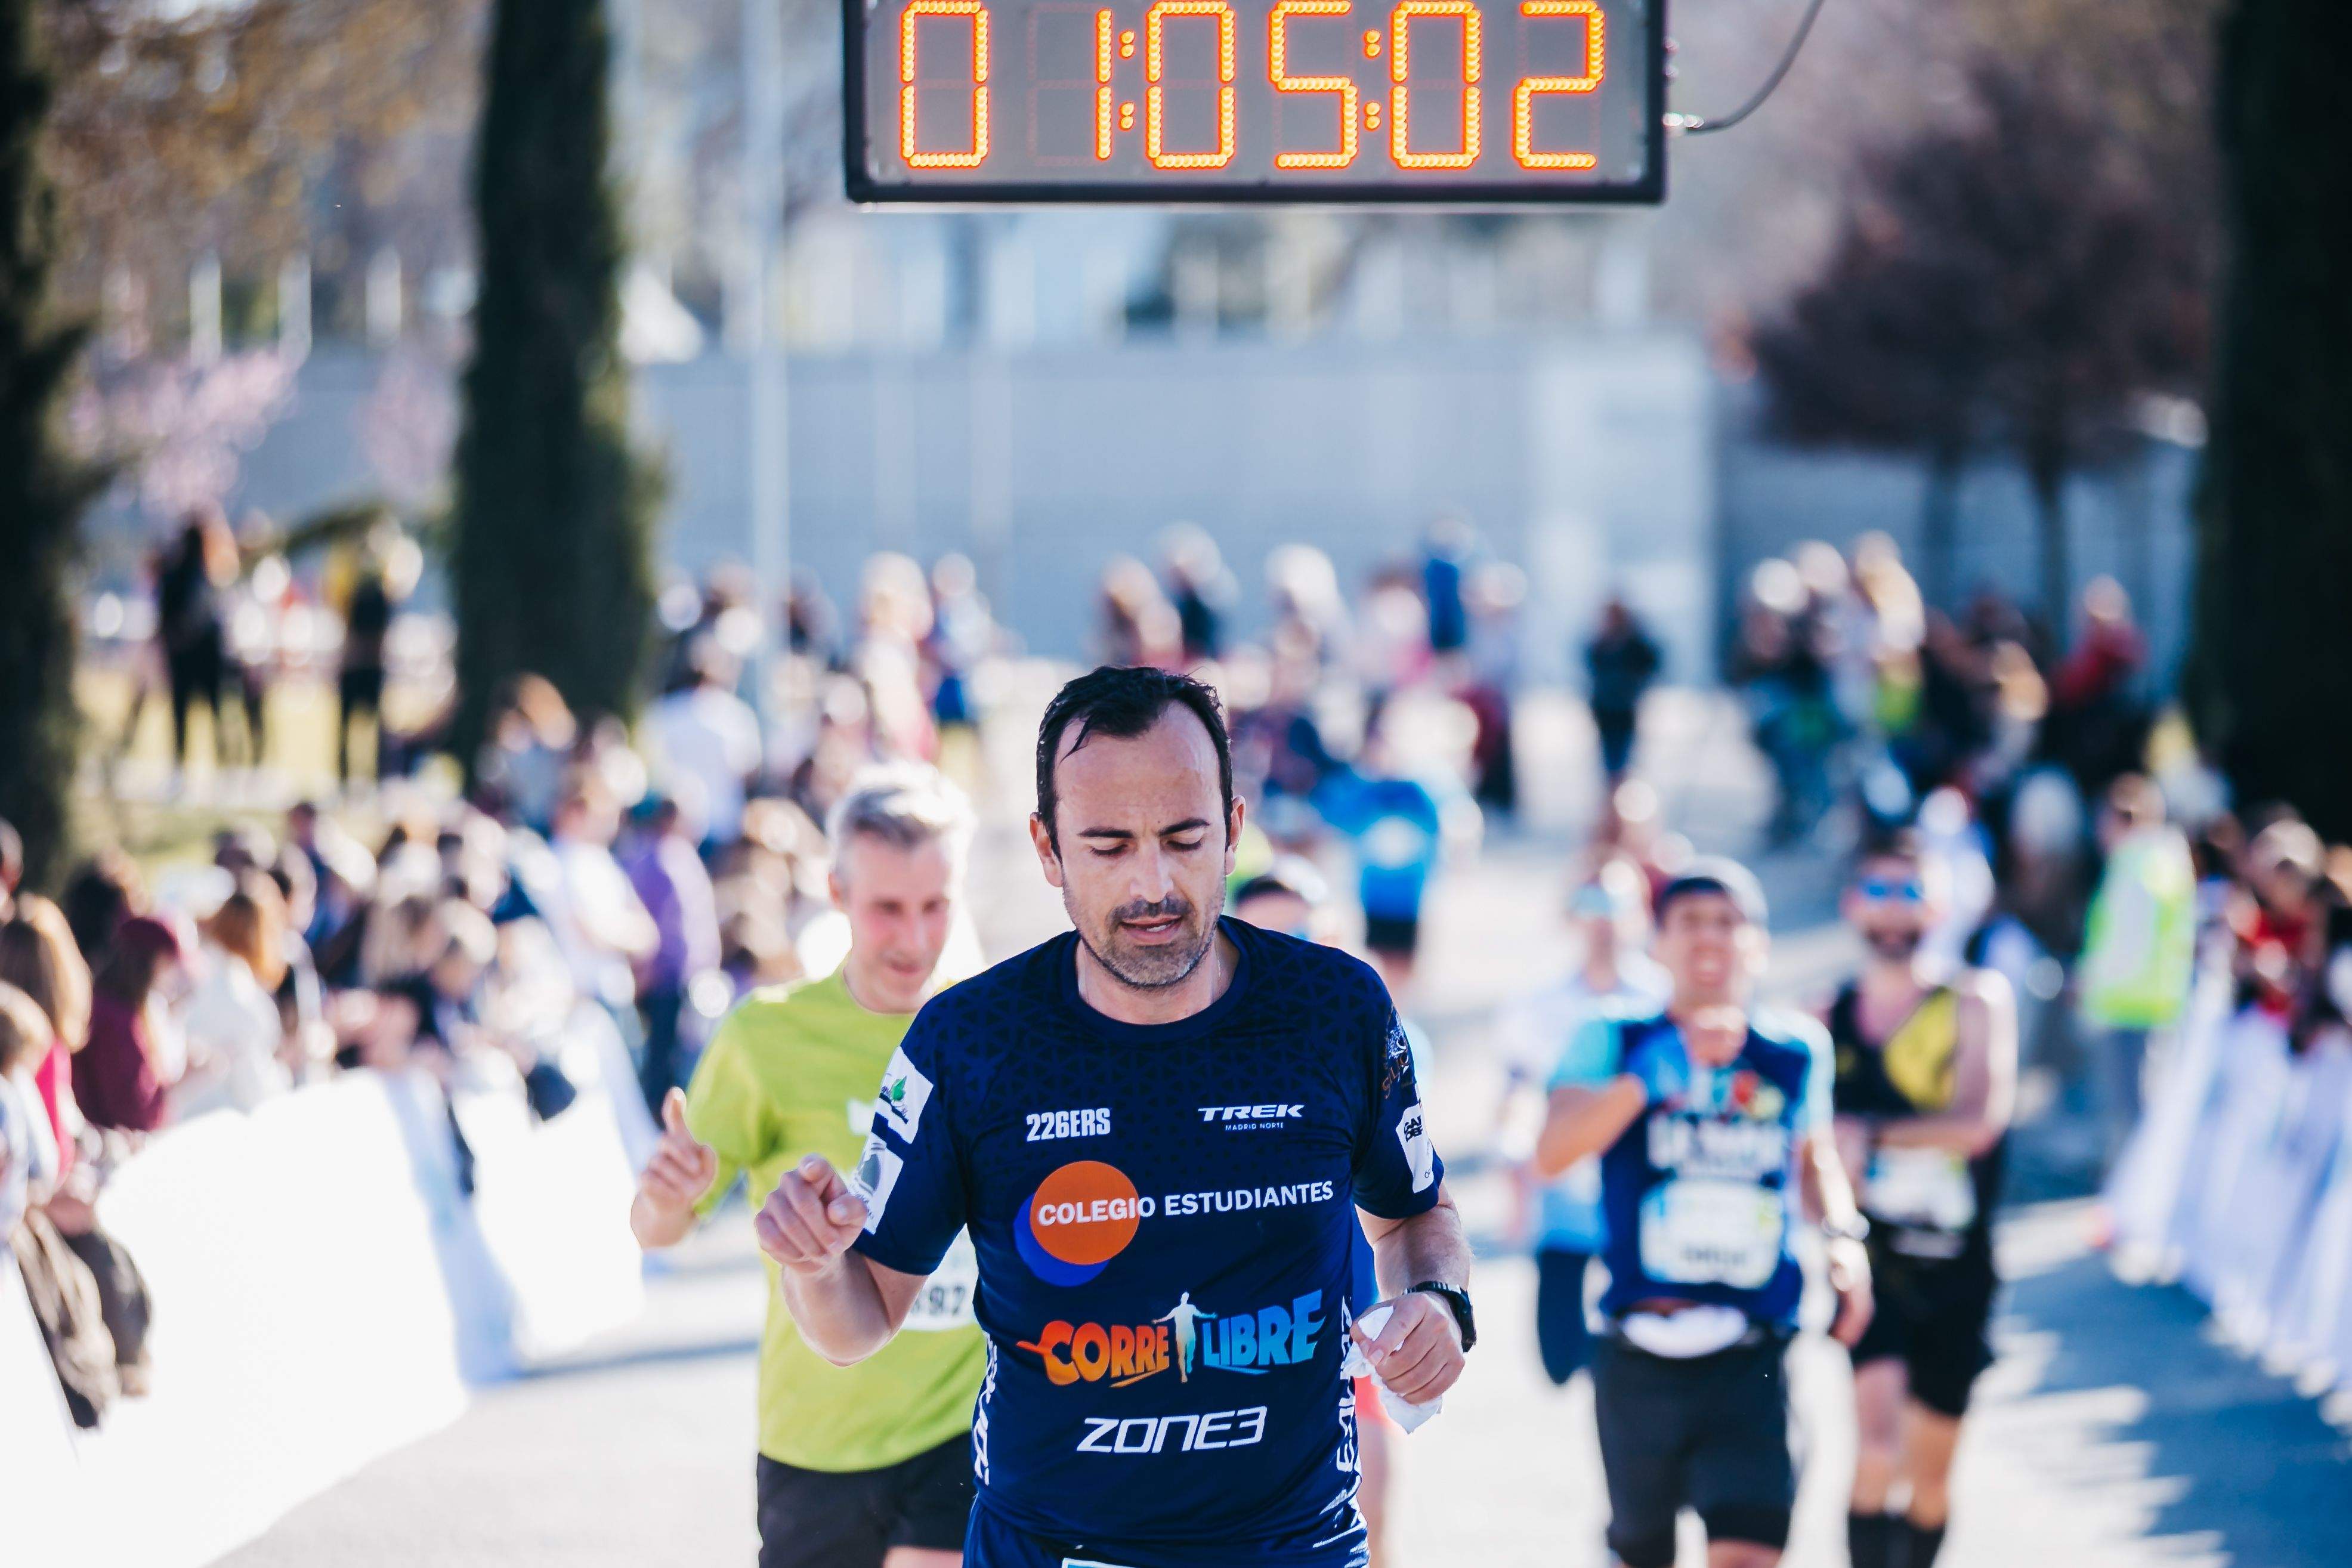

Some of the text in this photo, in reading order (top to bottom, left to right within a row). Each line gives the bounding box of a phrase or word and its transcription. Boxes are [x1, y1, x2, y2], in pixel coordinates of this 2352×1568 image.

[900, 0, 1606, 169] 01:05:02
[1026, 1108, 1111, 1142] 226ERS
[1198, 1104, 1305, 1122] TREK
[1037, 1180, 1334, 1229] COLEGIO ESTUDIANTES
[1016, 1289, 1326, 1387] CORRE LIBRE
[1077, 1406, 1268, 1453] ZONE3
